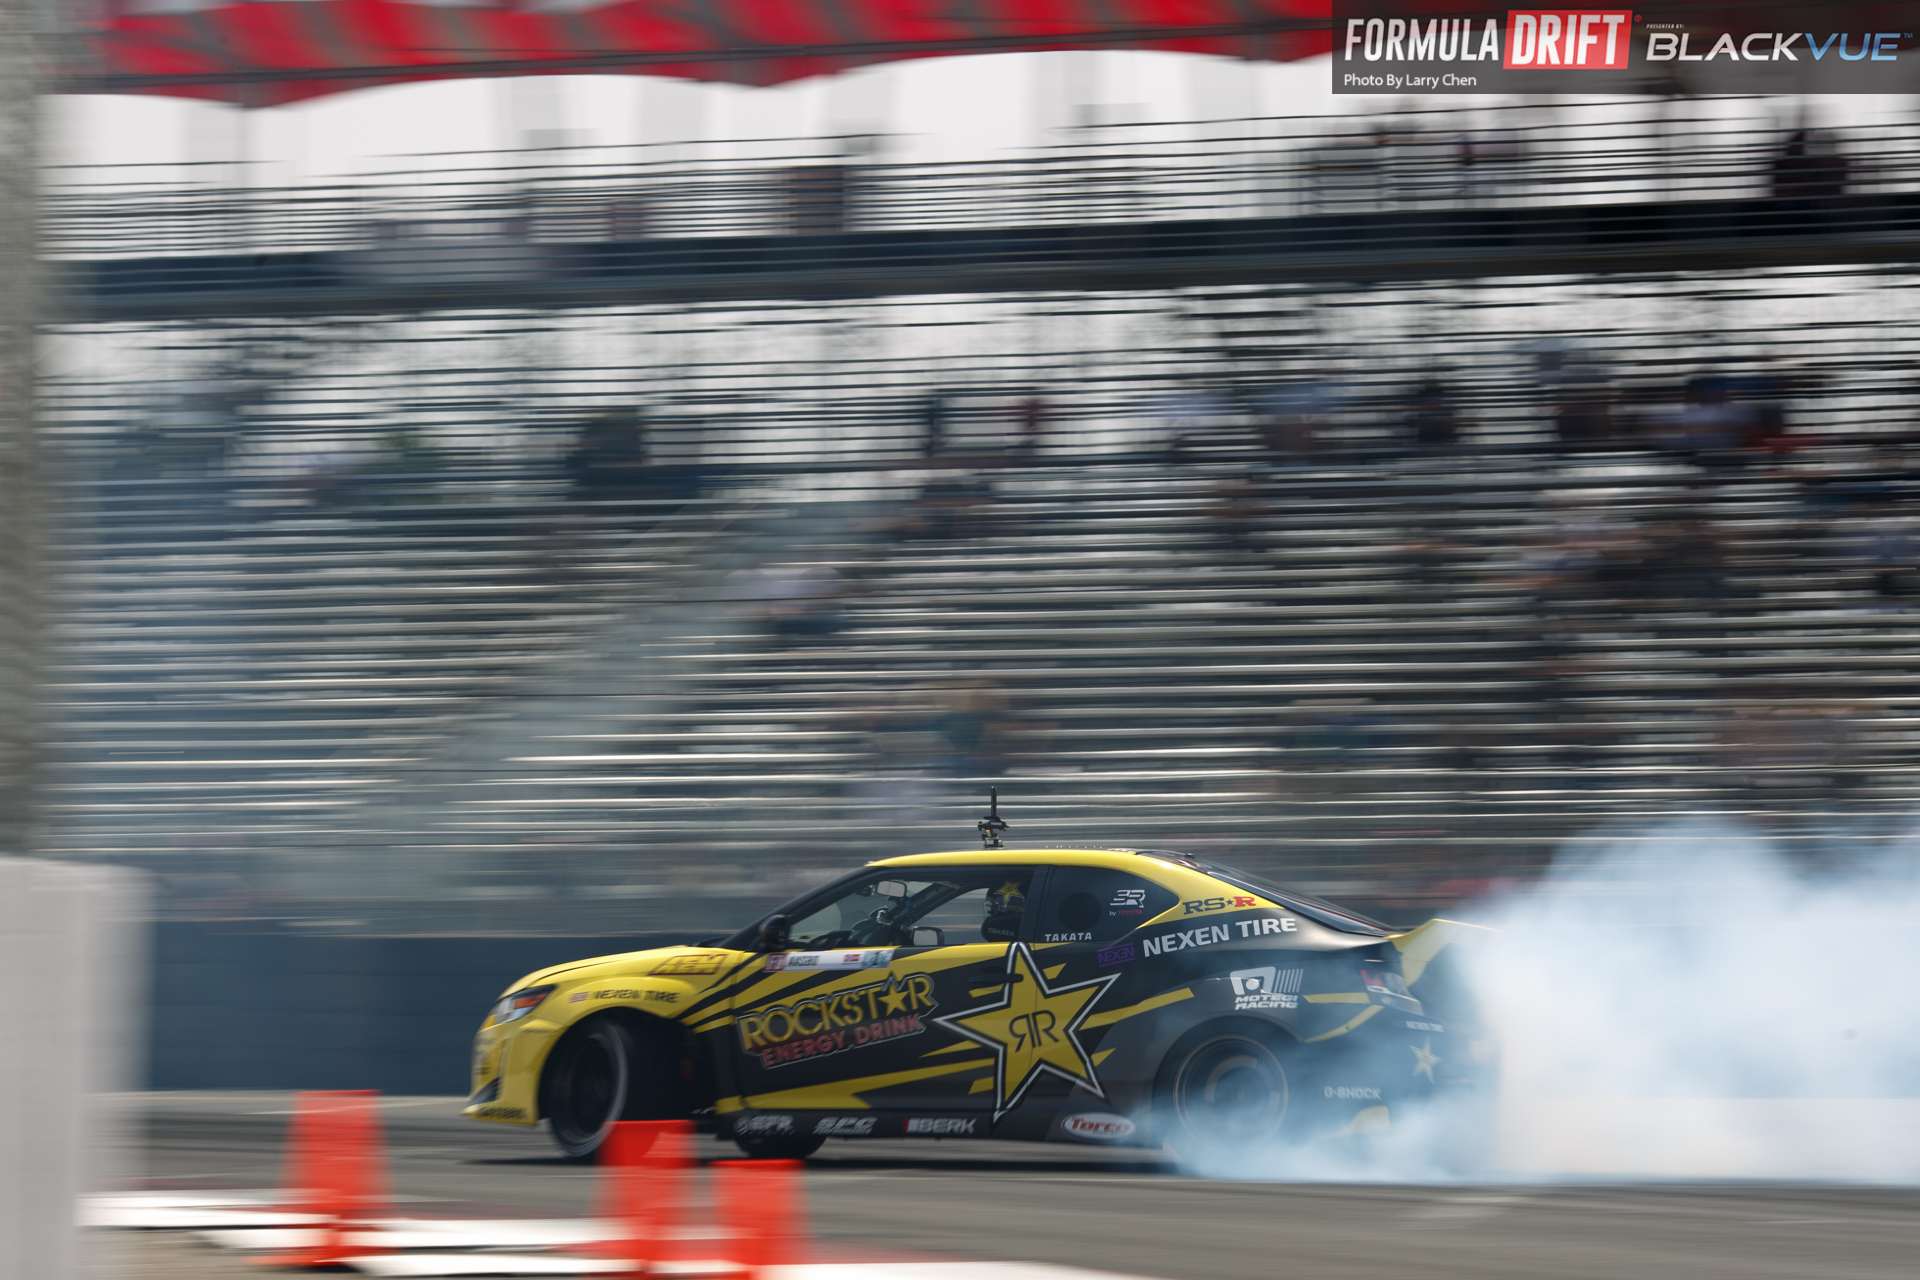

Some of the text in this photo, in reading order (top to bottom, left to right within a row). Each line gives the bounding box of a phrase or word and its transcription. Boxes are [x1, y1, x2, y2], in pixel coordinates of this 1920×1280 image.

[988, 927, 1014, 937] TAKATA
[1044, 932, 1092, 942] TAKATA
[1143, 917, 1298, 958] NEXEN TIRE
[648, 954, 728, 975] AEM
[593, 989, 642, 1000] NEXEN
[643, 990, 680, 1003] TIRE
[1235, 995, 1299, 1004] MOTEGI
[1235, 1002, 1299, 1010] RACING
[762, 1013, 923, 1066] ENERGY DRINK
[918, 1118, 976, 1134] BERK
[1071, 1116, 1130, 1132] Torco
